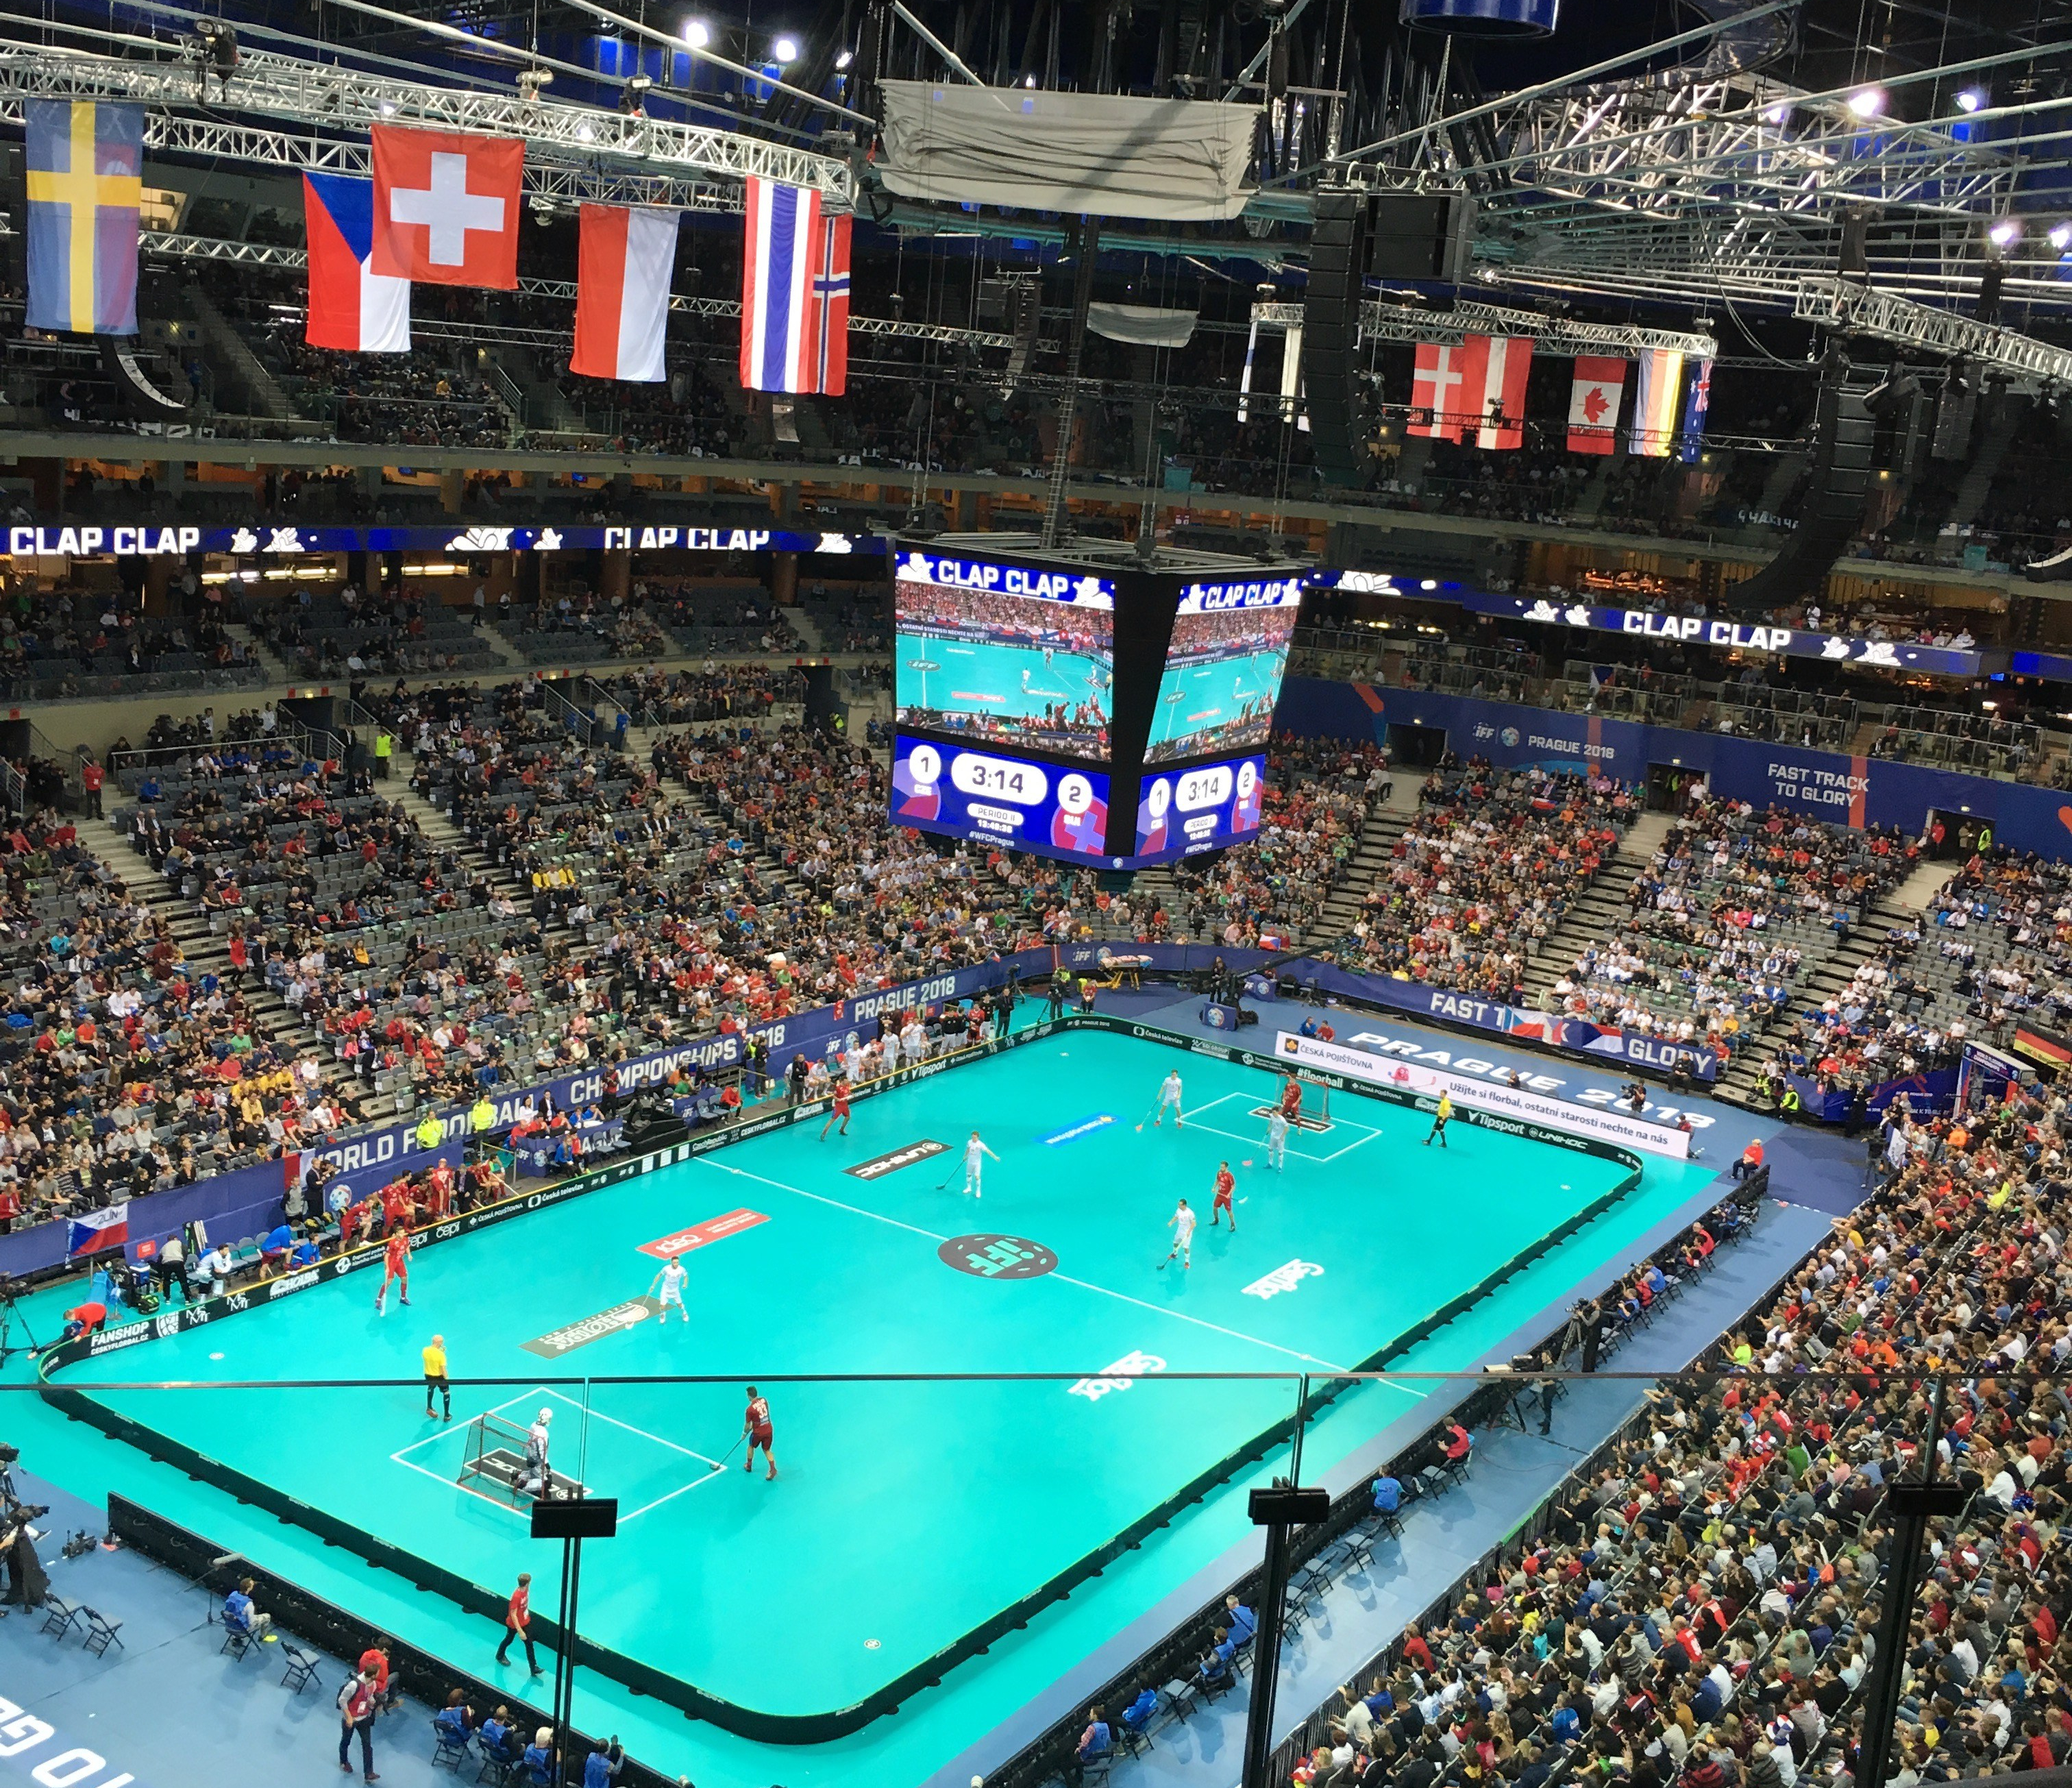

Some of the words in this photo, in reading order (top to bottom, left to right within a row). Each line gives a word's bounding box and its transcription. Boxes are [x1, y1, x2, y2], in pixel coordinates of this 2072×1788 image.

[10, 527, 103, 555] CLAP
[114, 527, 199, 554] CLAP
[687, 528, 769, 551] CLAP
[939, 560, 999, 589] CLAP
[1006, 570, 1068, 598] CLAP
[1205, 585, 1244, 609] CLAP
[1245, 583, 1281, 607] CLAP
[1623, 611, 1701, 639] CLAP
[1710, 622, 1791, 650] CLAP
[1528, 735, 1580, 753] PRAGUE
[1584, 744, 1614, 759] 2018
[920, 757, 930, 772] 1
[972, 765, 1024, 794] 3:14
[1188, 776, 1219, 801] 3:14
[1243, 772, 1250, 788] 2
[1768, 763, 1810, 782] FAST
[1814, 770, 1870, 792] TRACK
[1069, 785, 1081, 803] 2
[1156, 789, 1163, 805] 1
[1775, 782, 1796, 798] TO
[1801, 786, 1858, 807] GLORY
[978, 807, 1009, 821] PERIOD
[969, 831, 1015, 848] #WFCPrague
[854, 992, 916, 1022] PRAGUE
[921, 976, 956, 999] 2018
[1430, 994, 1489, 1022] FAST
[918, 1059, 946, 1077] Tipsport
[1300, 1042, 1324, 1058] ČESKÁ
[1326, 1050, 1373, 1070] POJIŠŤOVNA
[1296, 1067, 1344, 1088] #floorball
[1347, 1032, 1567, 1092] PRAGUE
[1576, 1088, 1716, 1129] 2018
[1450, 1081, 1477, 1097] Užijte
[1479, 1088, 1488, 1099] si
[1489, 1090, 1522, 1109] florbal,
[1525, 1101, 1559, 1116] ostatní
[1561, 1110, 1598, 1127] starosti
[1600, 1119, 1633, 1137] nechte
[1636, 1129, 1648, 1140] na
[1650, 1132, 1668, 1145] nás
[1479, 1112, 1525, 1136] Tipsport
[1539, 1130, 1588, 1149] UNIHOC
[856, 1146, 927, 1178] UNIHOC
[542, 1190, 560, 1201] Česká
[560, 1183, 584, 1195] televize
[478, 1209, 495, 1222] ČESKÁ
[285, 1269, 320, 1288] HOLBA
[90, 1321, 149, 1347] FANSHOP
[90, 1333, 149, 1356] CESKYFLORBAL.CZ
